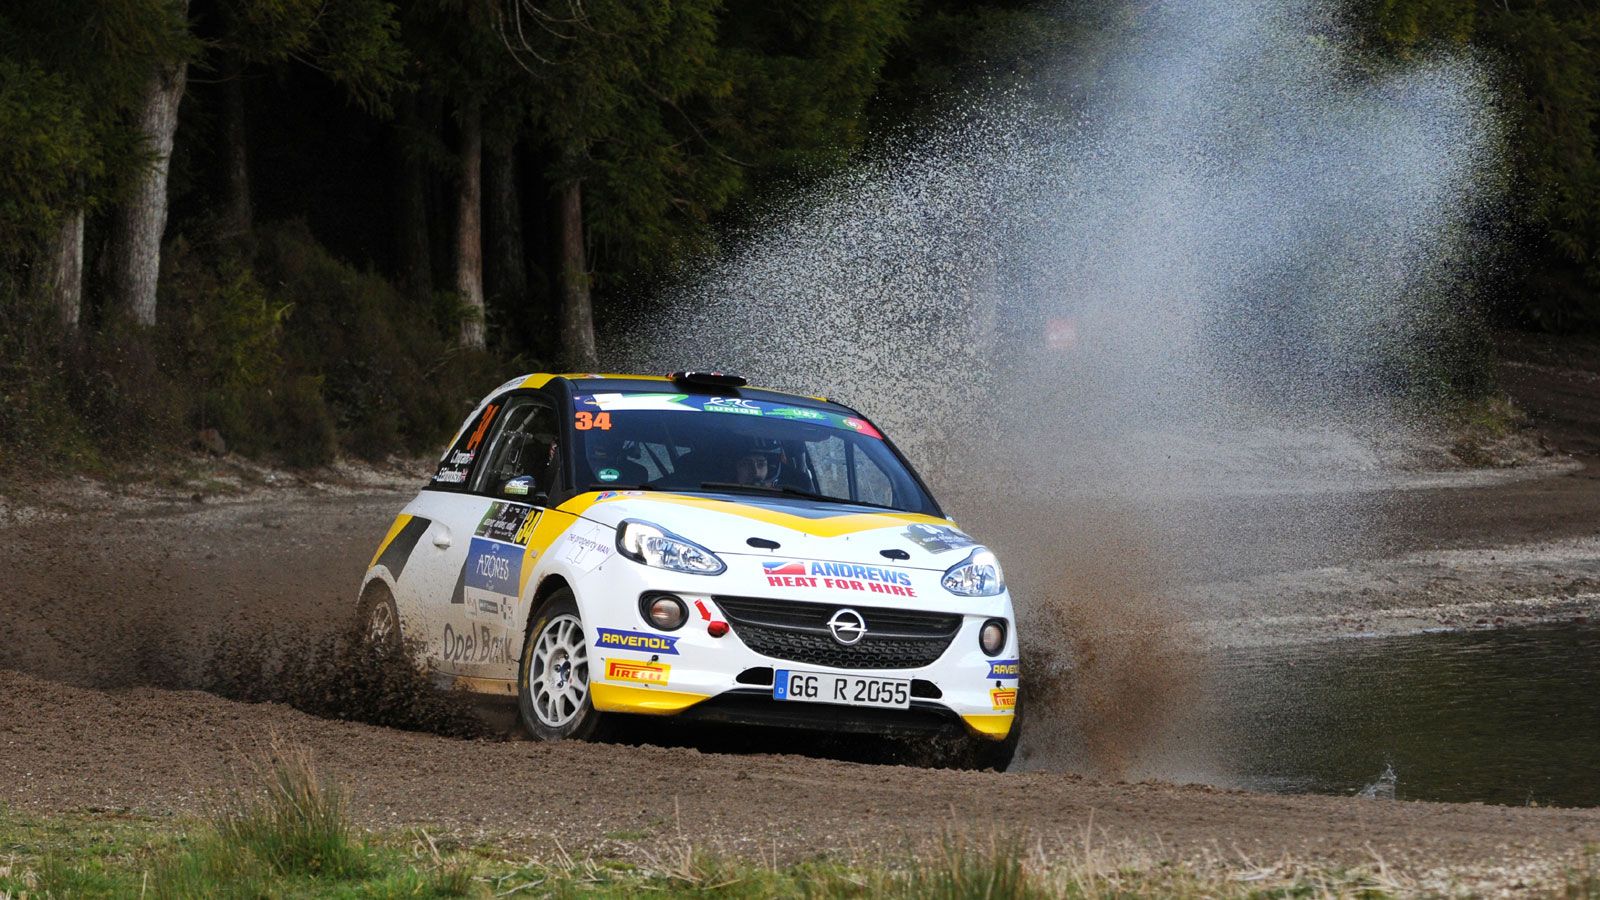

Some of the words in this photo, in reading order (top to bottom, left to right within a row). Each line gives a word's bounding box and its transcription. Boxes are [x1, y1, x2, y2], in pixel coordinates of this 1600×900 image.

[703, 397, 761, 409] ERC
[709, 406, 759, 415] JUNIOR
[574, 411, 612, 430] 34
[515, 510, 542, 544] 34
[476, 554, 510, 580] AZORES
[811, 561, 912, 586] ANDREWS
[767, 576, 817, 587] HEAT
[824, 578, 865, 591] FOR
[868, 582, 918, 597] HIRE
[444, 622, 477, 669] Opel
[602, 633, 670, 650] RAVENOL
[609, 662, 663, 681] PIRELLI
[789, 674, 818, 698] GG
[834, 678, 848, 701] R
[853, 679, 908, 704] 2055
